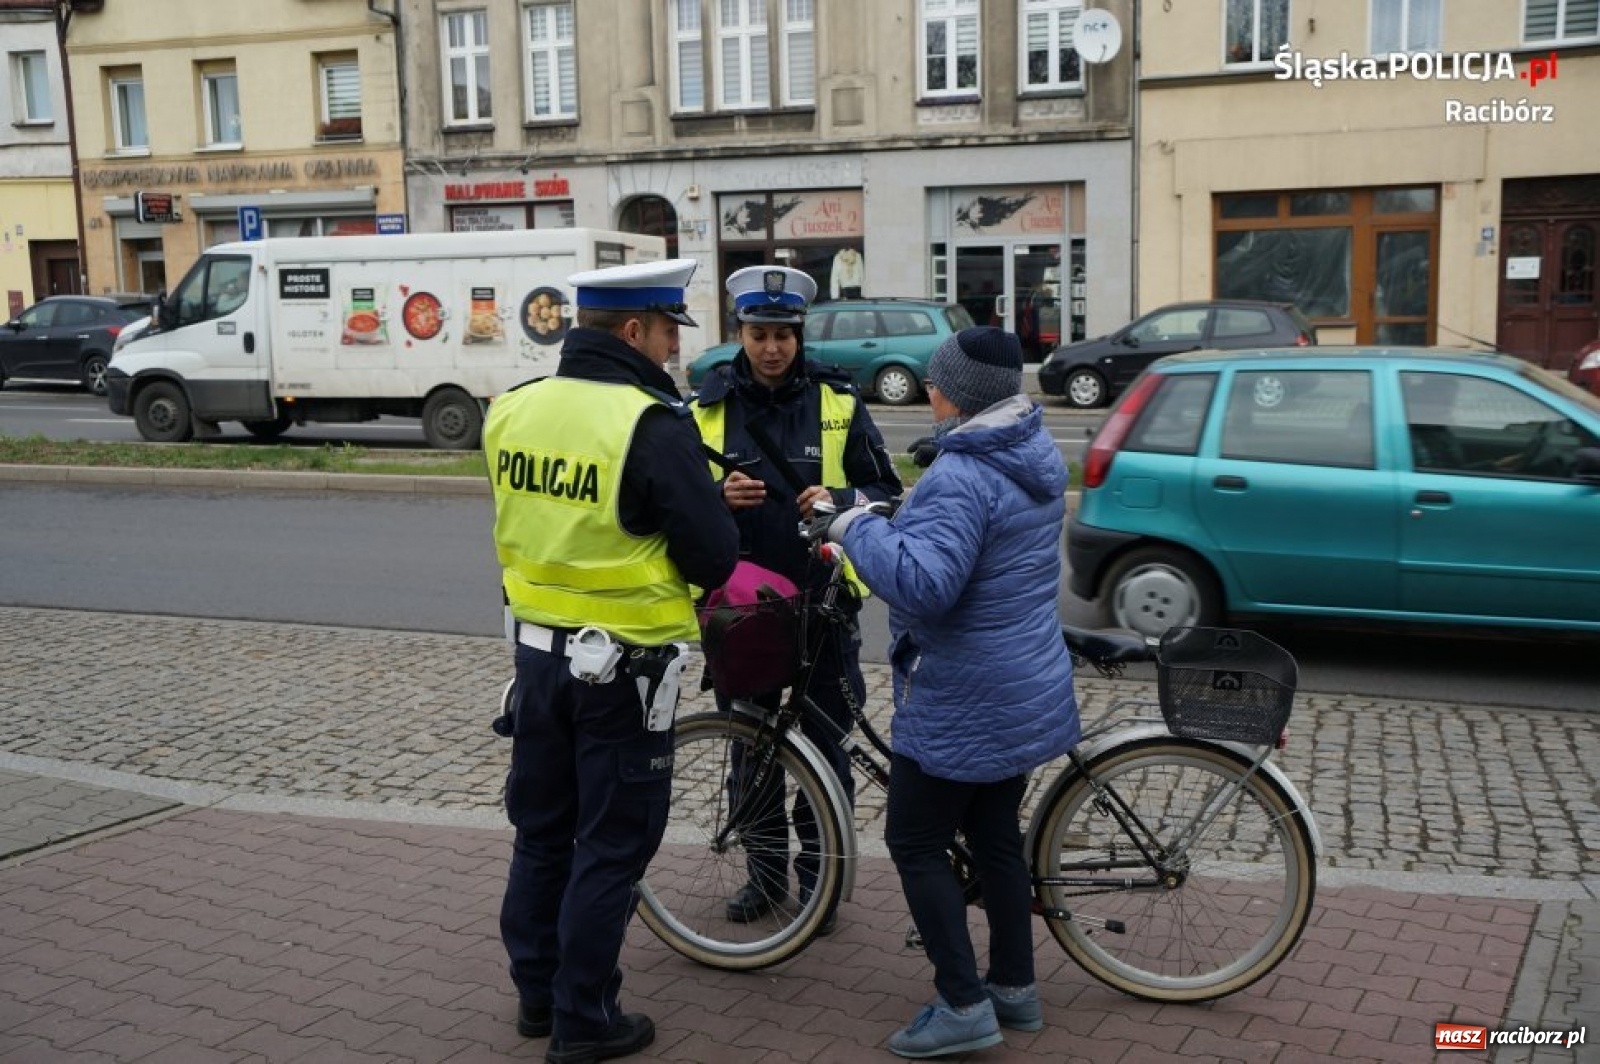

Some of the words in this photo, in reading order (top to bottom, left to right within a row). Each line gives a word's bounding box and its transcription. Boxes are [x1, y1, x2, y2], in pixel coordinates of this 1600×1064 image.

[207, 161, 293, 183] NAPRAWA
[444, 181, 526, 200] MALOWANIE
[815, 196, 842, 217] Ani
[243, 210, 257, 238] P
[790, 215, 845, 237] Ciuszek
[847, 211, 858, 232] 2
[283, 284, 326, 293] HISTORIE
[286, 274, 321, 283] PROSTE
[820, 418, 850, 431] OLICJA
[804, 446, 823, 457] POL
[497, 448, 599, 504] POLICJA
